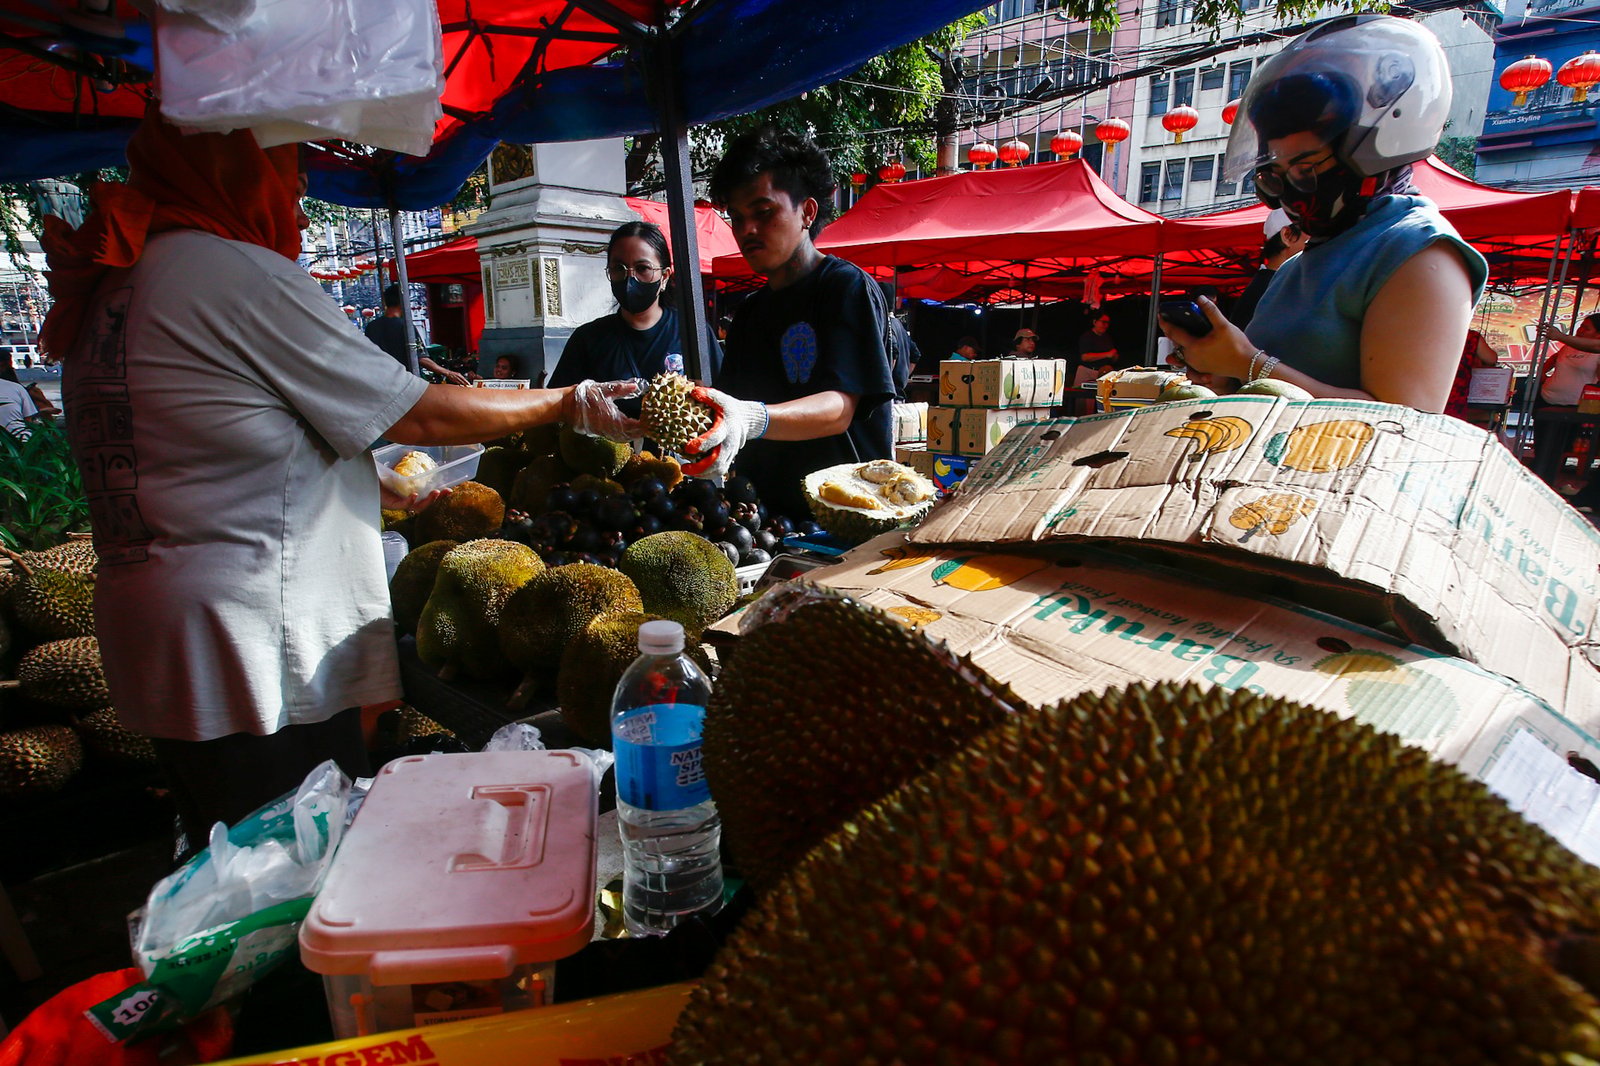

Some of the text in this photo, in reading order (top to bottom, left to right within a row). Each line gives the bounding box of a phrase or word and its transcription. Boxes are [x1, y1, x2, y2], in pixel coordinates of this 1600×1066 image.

[1492, 115, 1541, 126] Xiamen Skyline
[1021, 367, 1050, 382] Baukh
[1105, 597, 1190, 627] harvest
[1031, 591, 1266, 697] Barukh
[1191, 620, 1274, 655] freshly
[672, 747, 702, 764] NAT
